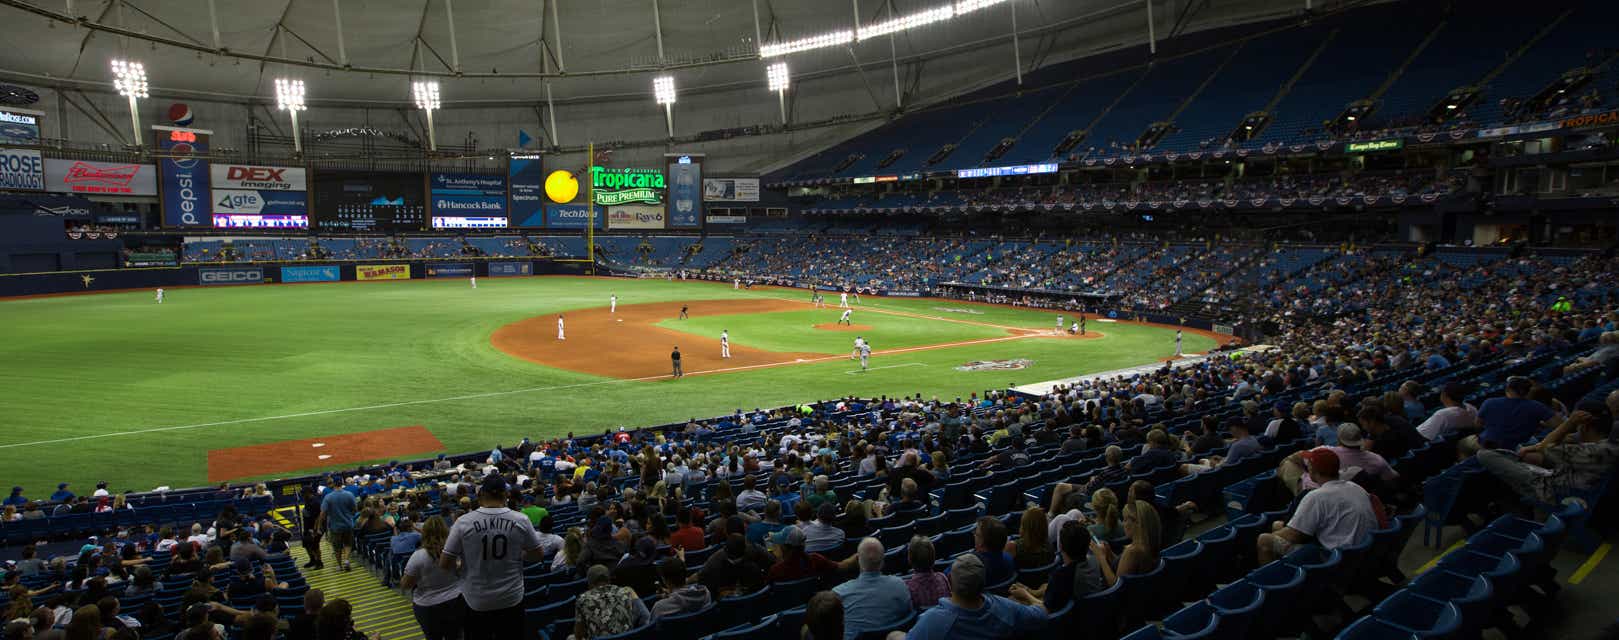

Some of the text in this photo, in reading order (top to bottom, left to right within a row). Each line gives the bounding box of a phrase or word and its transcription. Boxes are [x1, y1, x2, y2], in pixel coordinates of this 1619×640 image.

[0, 155, 41, 173] ROSE
[227, 167, 286, 182] DEX
[588, 166, 664, 190] Tropicana
[176, 174, 199, 224] pepsi
[233, 193, 257, 206] gte
[597, 190, 655, 202] PURE PREMIUM
[447, 201, 481, 209] Hancock
[559, 210, 598, 218] Tech Daa
[202, 271, 261, 281] GEICO
[490, 517, 517, 531] KITTY
[482, 534, 507, 560] 10
